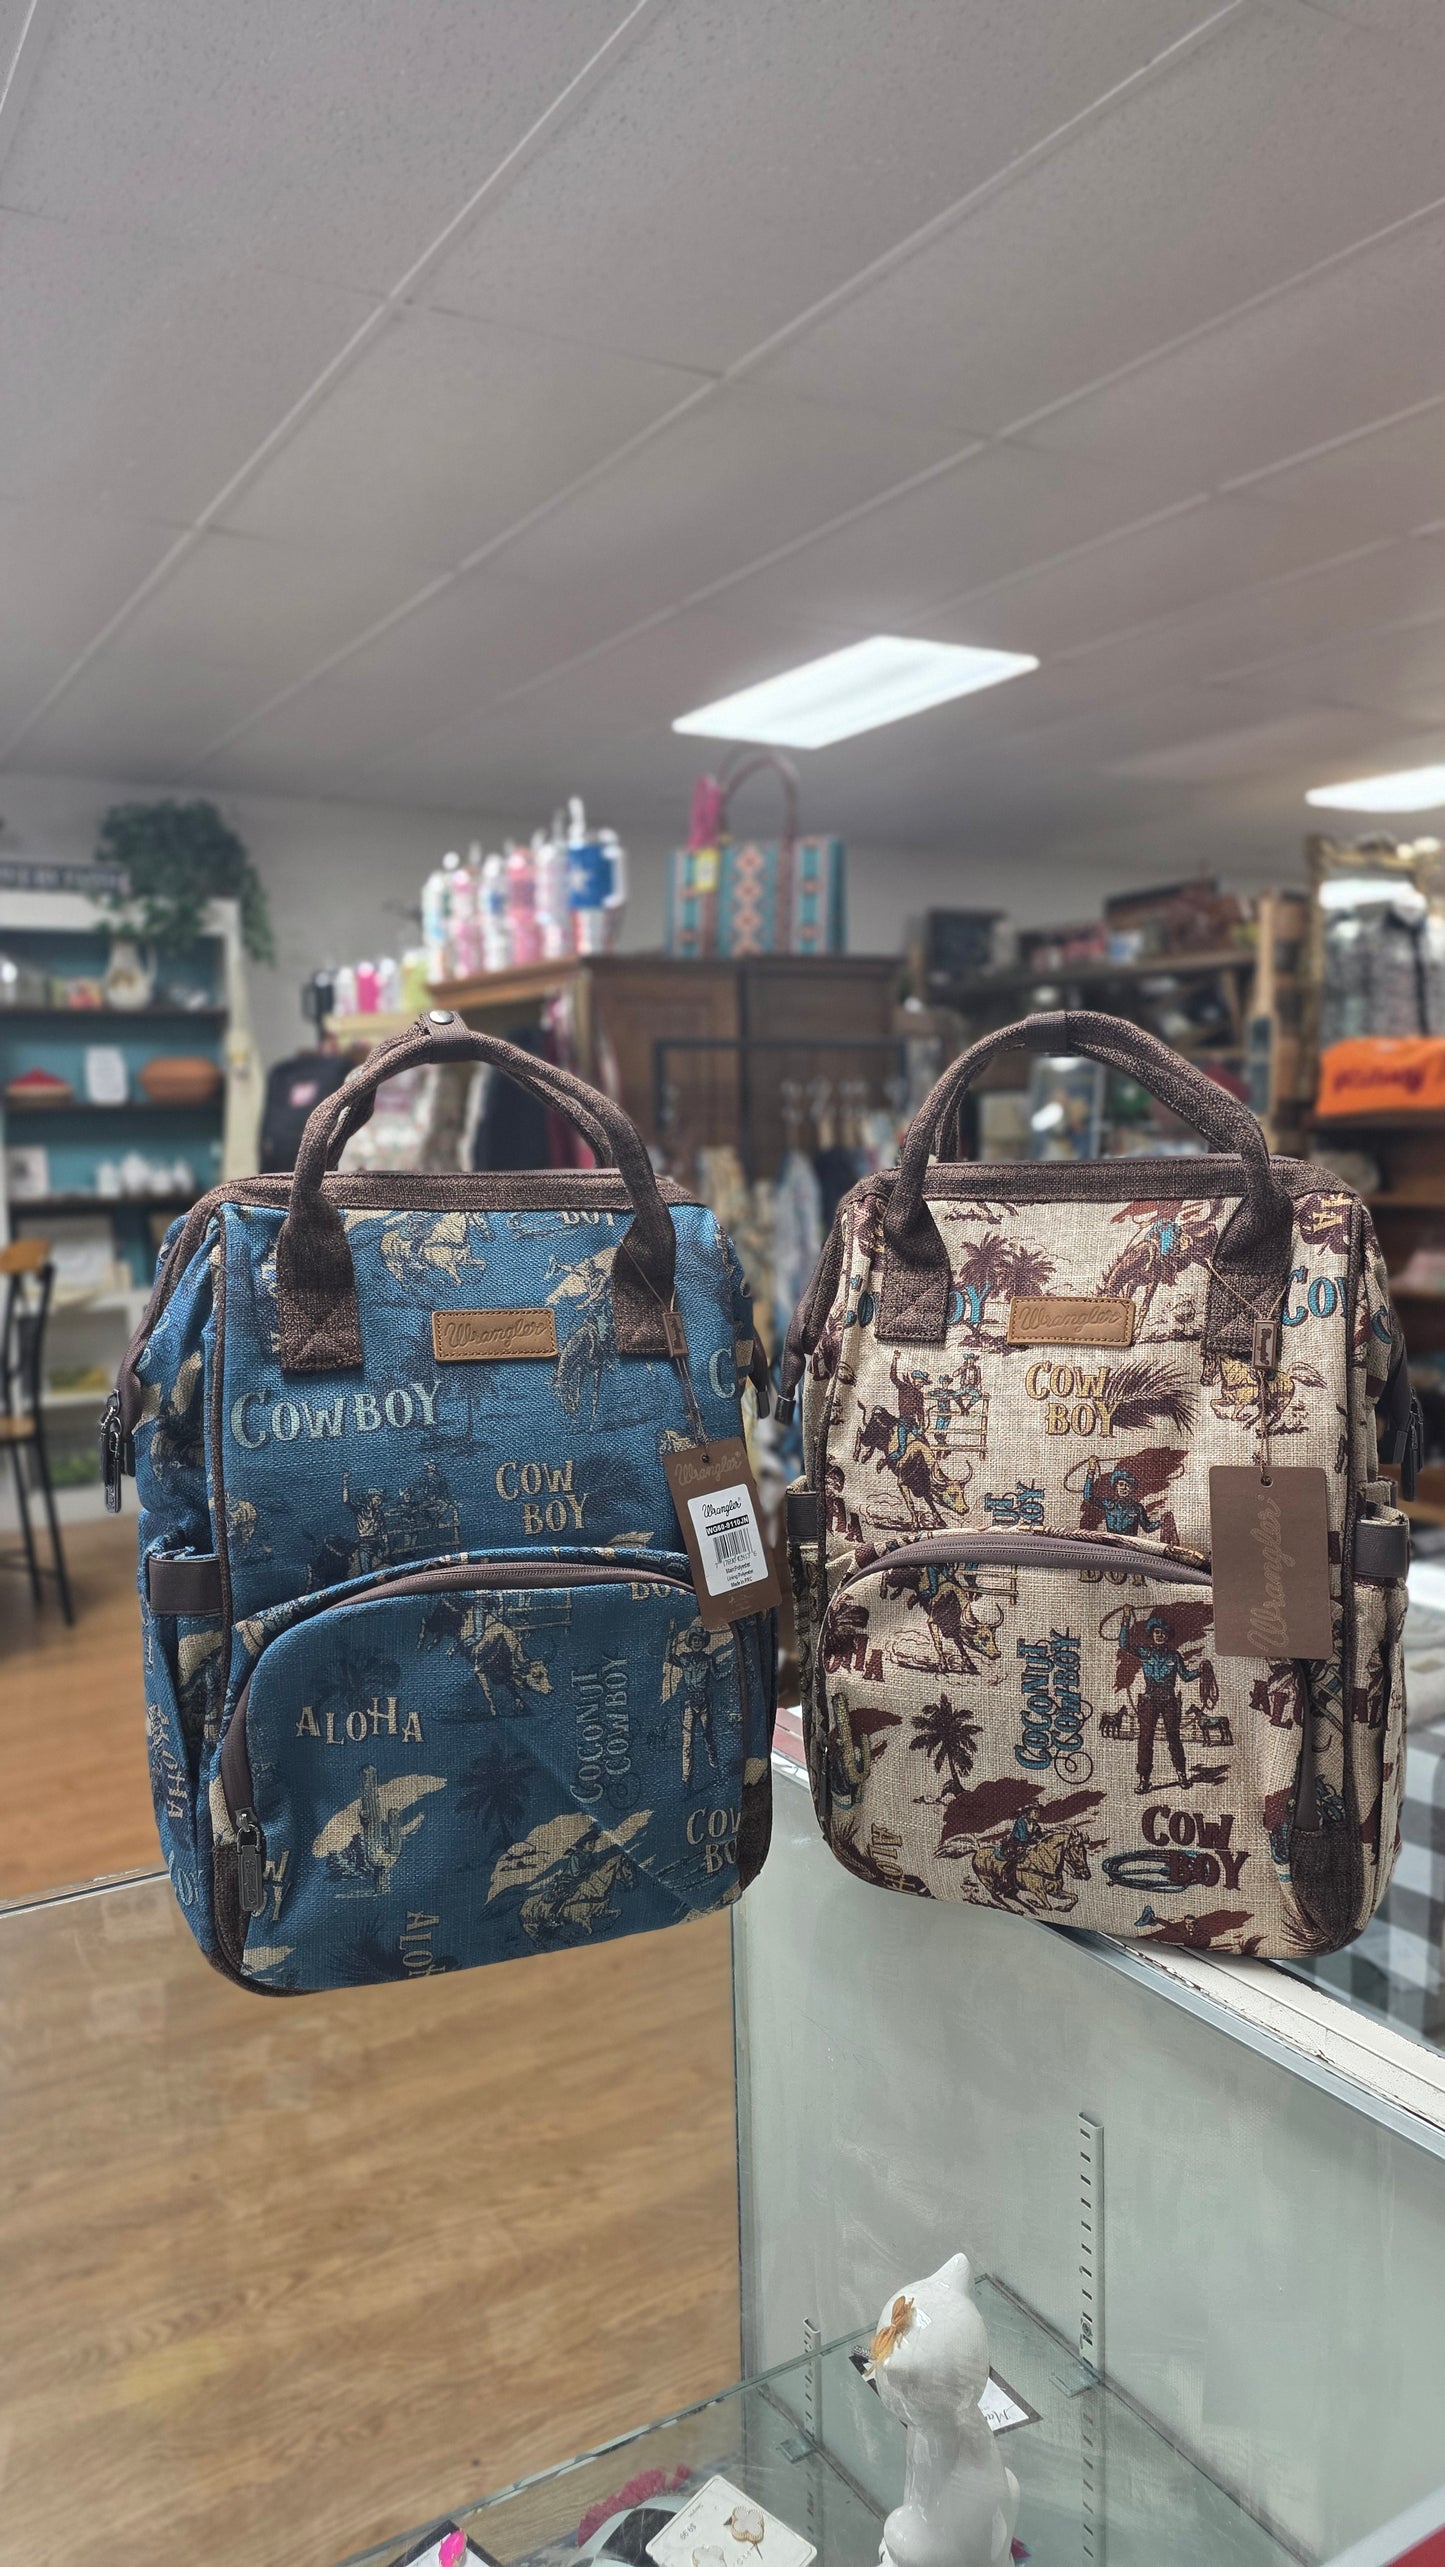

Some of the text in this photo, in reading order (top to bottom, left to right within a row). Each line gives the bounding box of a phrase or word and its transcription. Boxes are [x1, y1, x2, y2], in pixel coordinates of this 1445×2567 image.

[443, 1319, 549, 1347] Wrangler
[1018, 1303, 1122, 1334] Wrangler
[1024, 1361, 1109, 1401] COW
[230, 1380, 441, 1450] COWBOY
[1044, 1400, 1116, 1440] BOY
[495, 1459, 574, 1501] COW
[675, 1454, 742, 1487] Wrangler
[523, 1492, 591, 1536] BOY
[702, 1500, 742, 1519] Wrangler
[1246, 1497, 1296, 1653] Wrangler
[1015, 1637, 1054, 1771] COCONUT
[1051, 1626, 1083, 1753] COWBOY
[295, 1696, 425, 1746] ALOHA
[570, 1668, 606, 1804] COCONUT
[603, 1654, 630, 1777] COWBOY
[1141, 1804, 1235, 1850] COW
[1167, 1850, 1251, 1892] BOY
